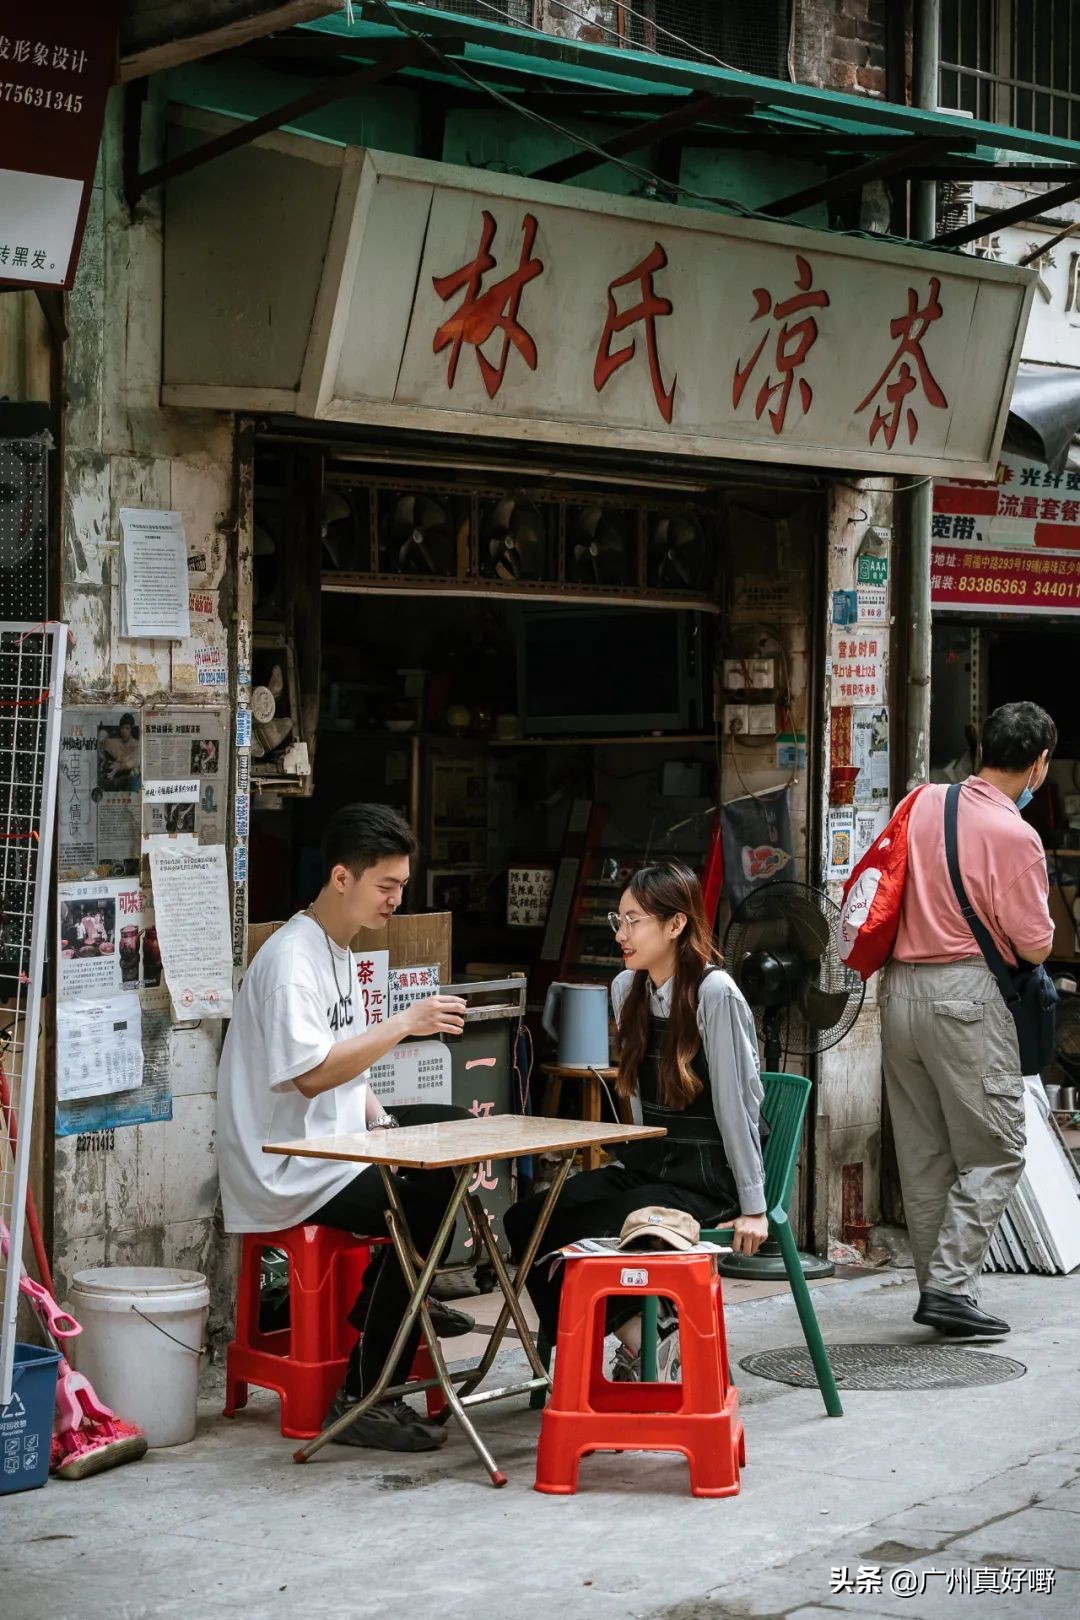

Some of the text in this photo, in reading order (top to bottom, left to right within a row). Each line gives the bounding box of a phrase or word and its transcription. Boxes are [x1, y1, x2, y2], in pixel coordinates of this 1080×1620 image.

[432, 209, 948, 450] 林氏凉茶
[958, 576, 1027, 595] 83386363
[838, 640, 877, 659] 营业时间
[357, 960, 374, 984] 茶
